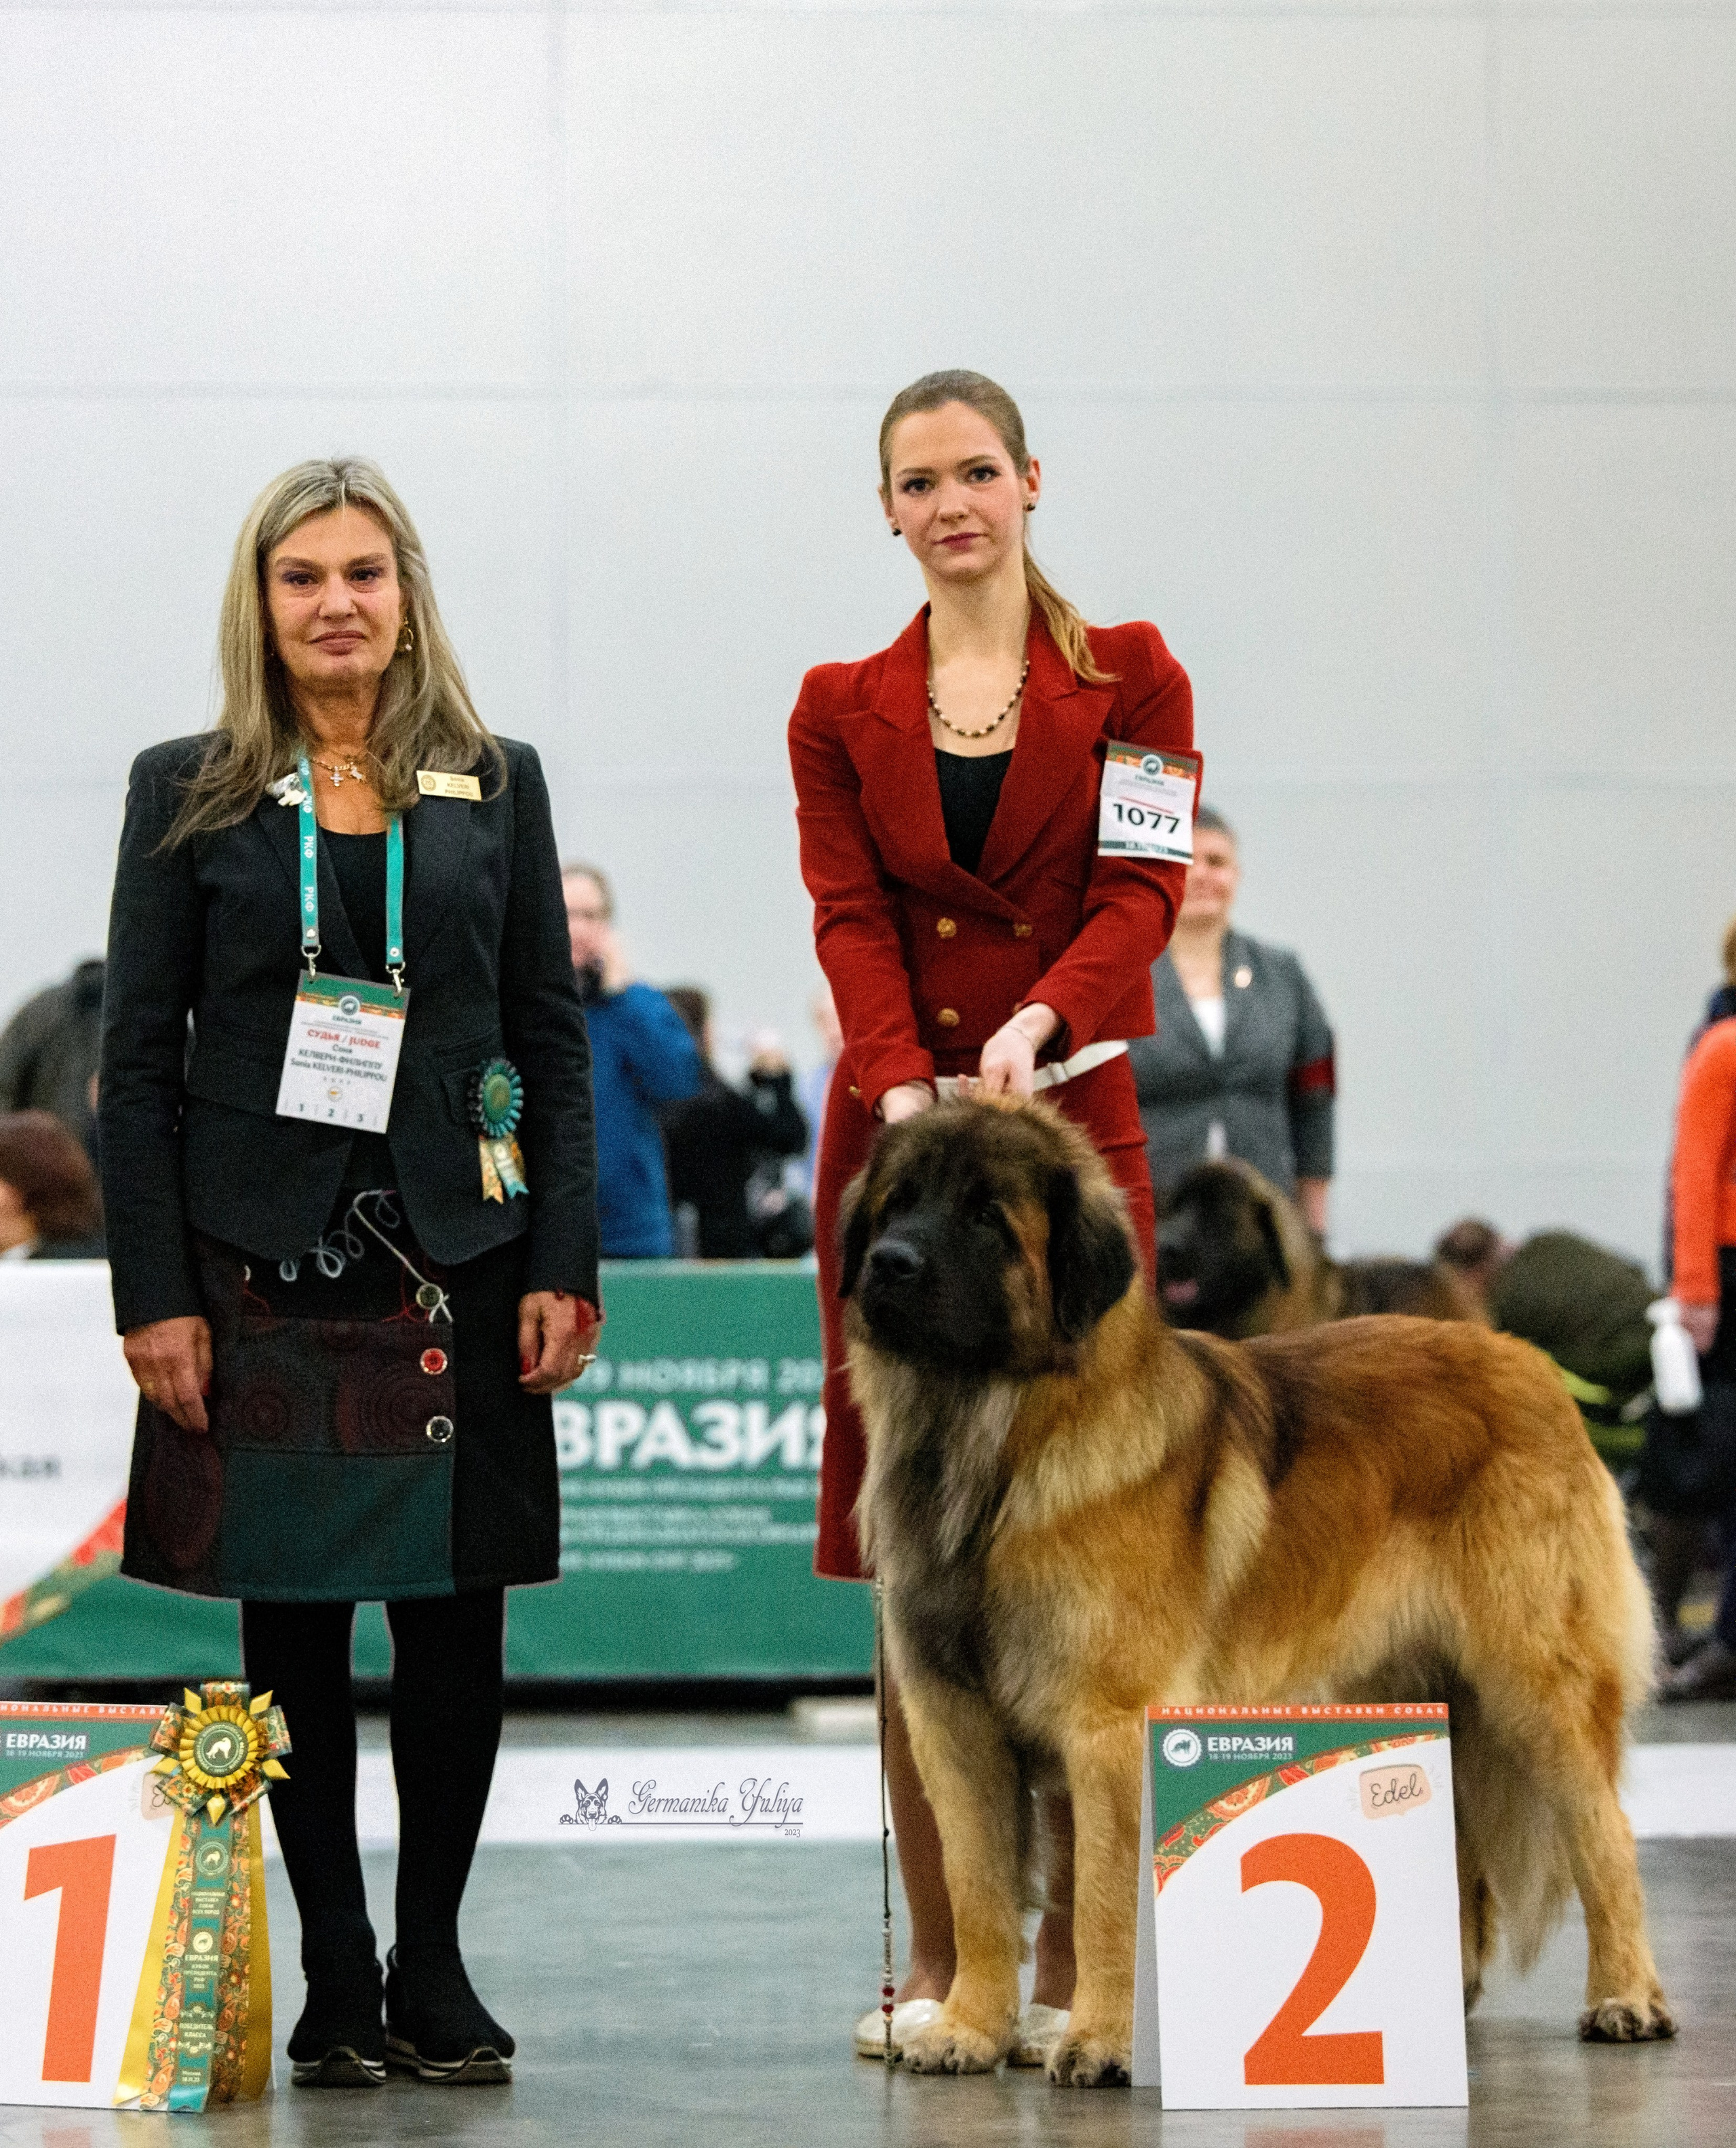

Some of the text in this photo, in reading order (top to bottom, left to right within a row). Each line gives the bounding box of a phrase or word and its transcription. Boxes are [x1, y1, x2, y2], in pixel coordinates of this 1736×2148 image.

[1113, 803, 1180, 834] 1077
[304, 836, 314, 859] РКФ
[304, 886, 315, 912] РКФ
[307, 1029, 340, 1041] СУДЬЯ
[349, 1036, 381, 1049] JUDGE
[332, 1044, 353, 1054] Соня
[291, 1057, 311, 1069] Sonia
[299, 1104, 304, 1112] 1
[328, 1108, 334, 1117] 2
[1162, 1706, 1444, 1716] НАЦИОНАЛЬНЫЕ ВЫСТАВКИ СОБАК
[6, 1734, 87, 1750] ЕВРАЗИЯ
[1208, 1736, 1293, 1751] ЕВРАЗИЯ
[1370, 1774, 1423, 1807] Edel
[23, 1834, 117, 2083] 1
[184, 1954, 218, 1962] ЕВРАЗИЯ
[1240, 1832, 1385, 2086] 2
